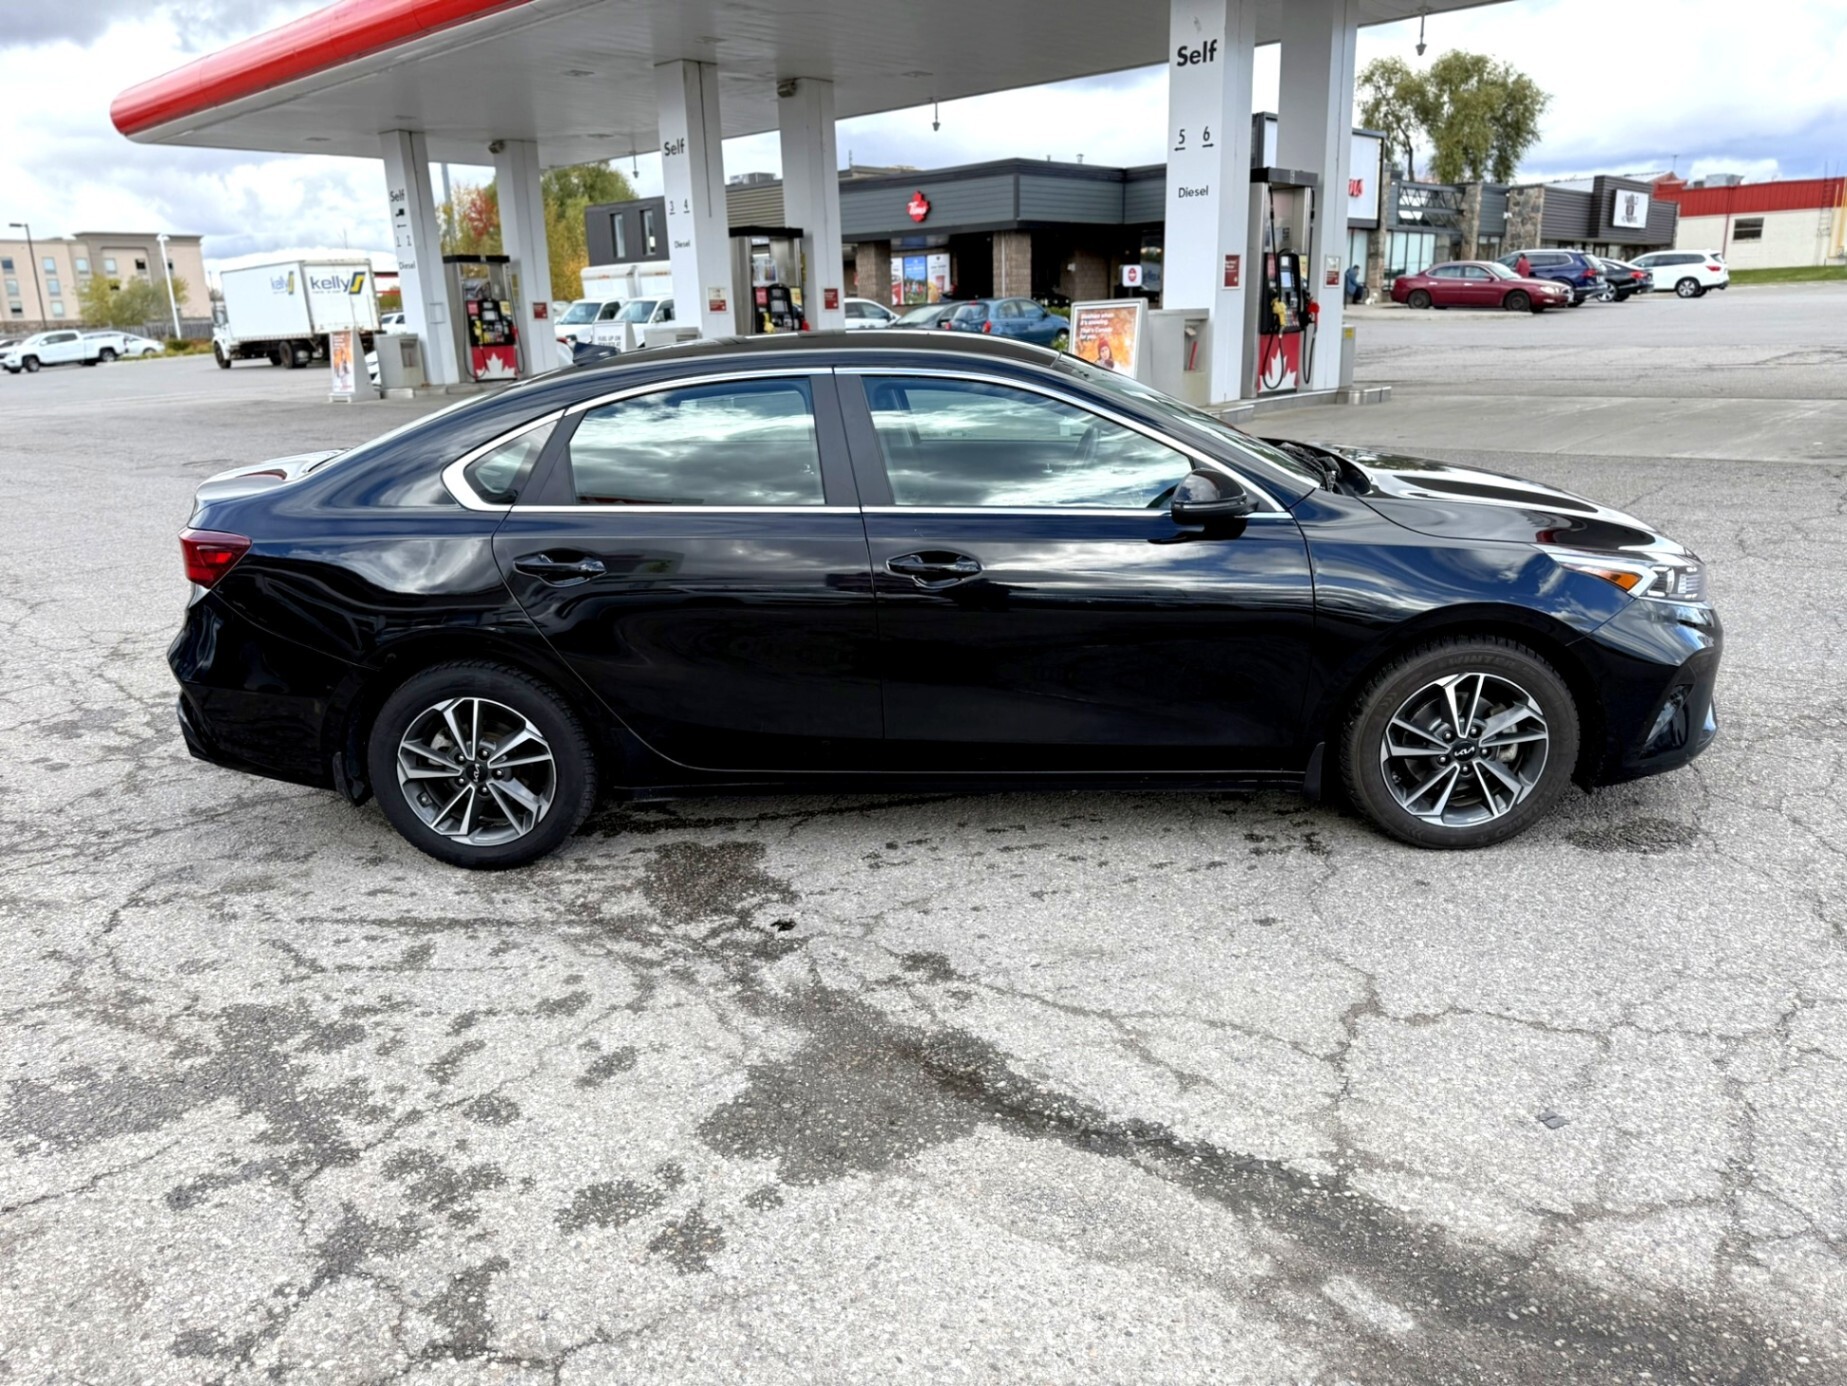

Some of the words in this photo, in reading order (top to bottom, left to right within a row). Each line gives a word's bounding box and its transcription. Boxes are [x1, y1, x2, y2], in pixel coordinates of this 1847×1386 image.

[1176, 39, 1218, 67] Self
[1178, 129, 1186, 144] 5
[1202, 126, 1210, 142] 6
[663, 138, 685, 156] Self
[389, 189, 405, 202] Self
[1178, 185, 1209, 198] Diesel
[310, 275, 350, 293] kelly
